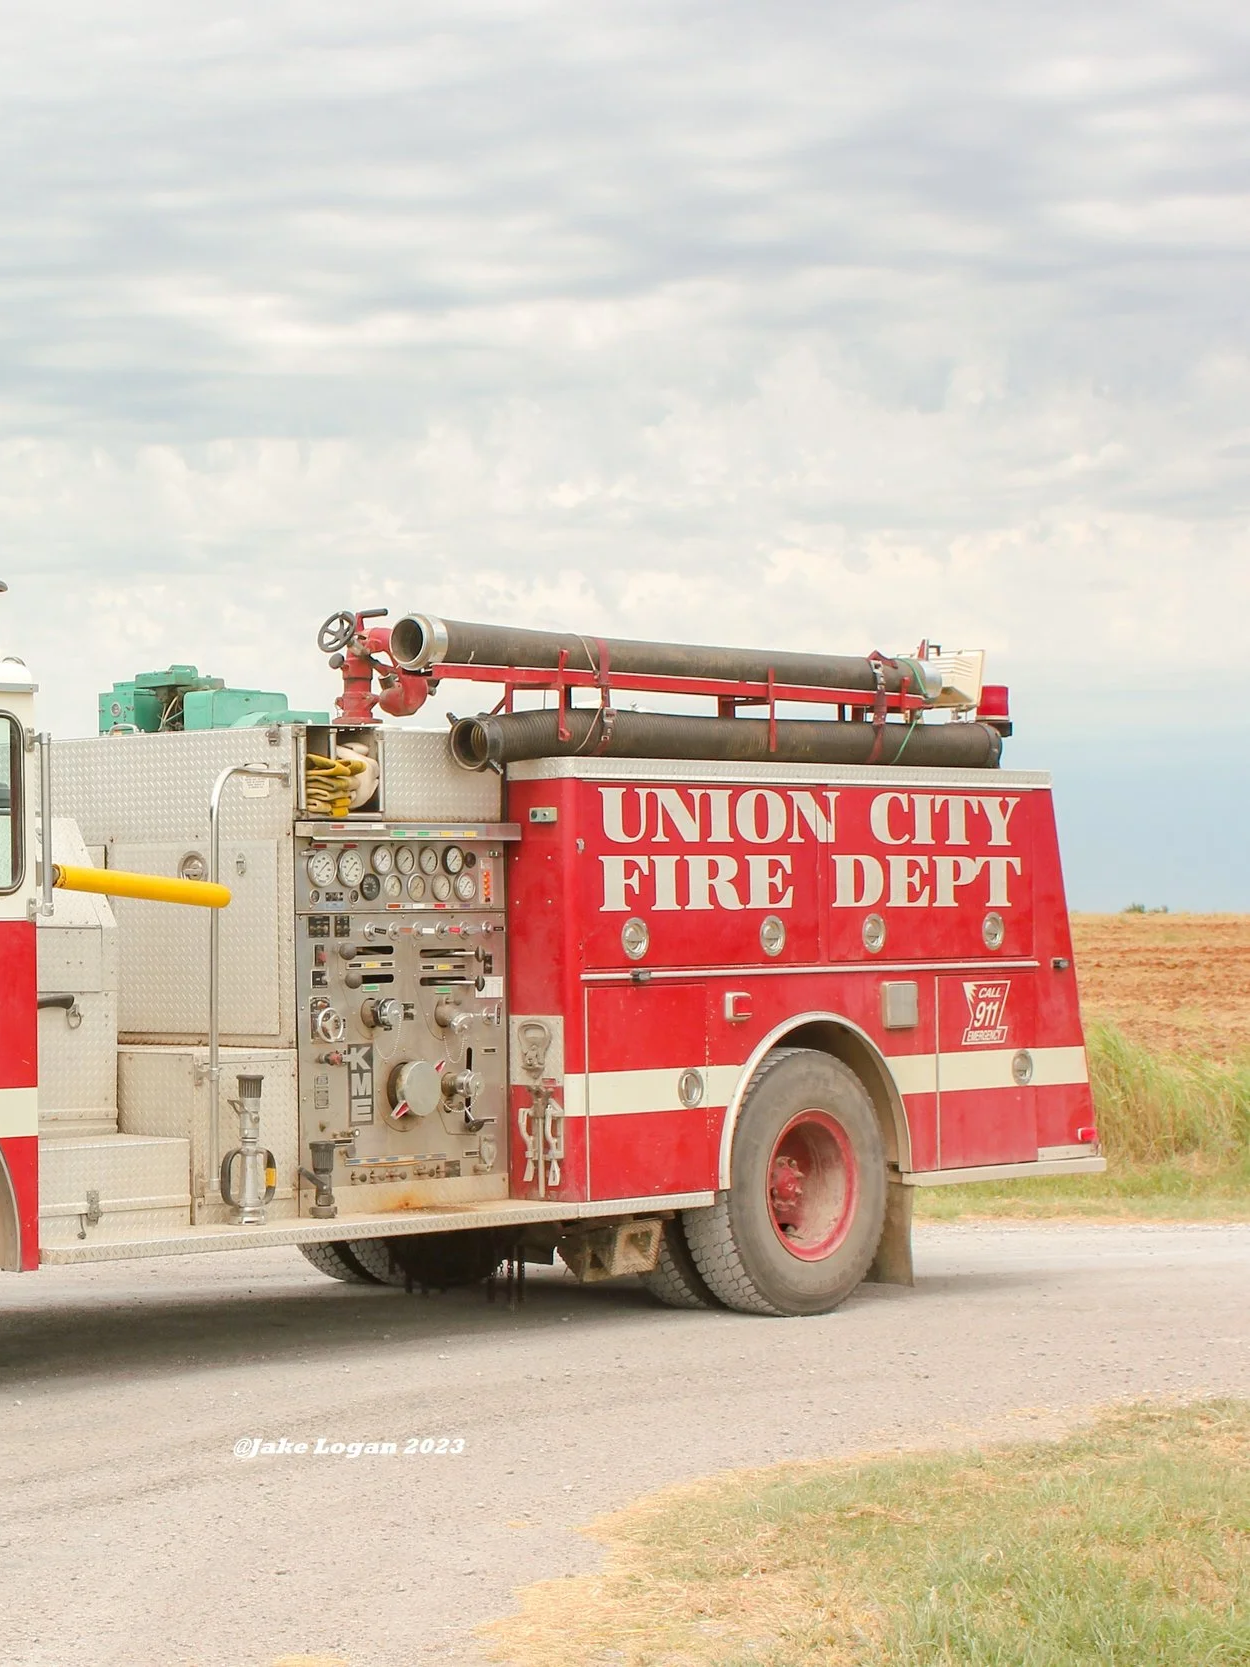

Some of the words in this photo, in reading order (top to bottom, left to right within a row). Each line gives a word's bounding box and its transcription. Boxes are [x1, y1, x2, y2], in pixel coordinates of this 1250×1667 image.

[597, 786, 840, 844] UNION
[869, 791, 1020, 847] CITY
[598, 854, 795, 912] FIRE
[831, 854, 1022, 908] DEPT
[978, 987, 1001, 999] CALL
[973, 1001, 1000, 1028] 911
[966, 1030, 1003, 1042] EMERGENCY
[350, 1046, 373, 1122] KME
